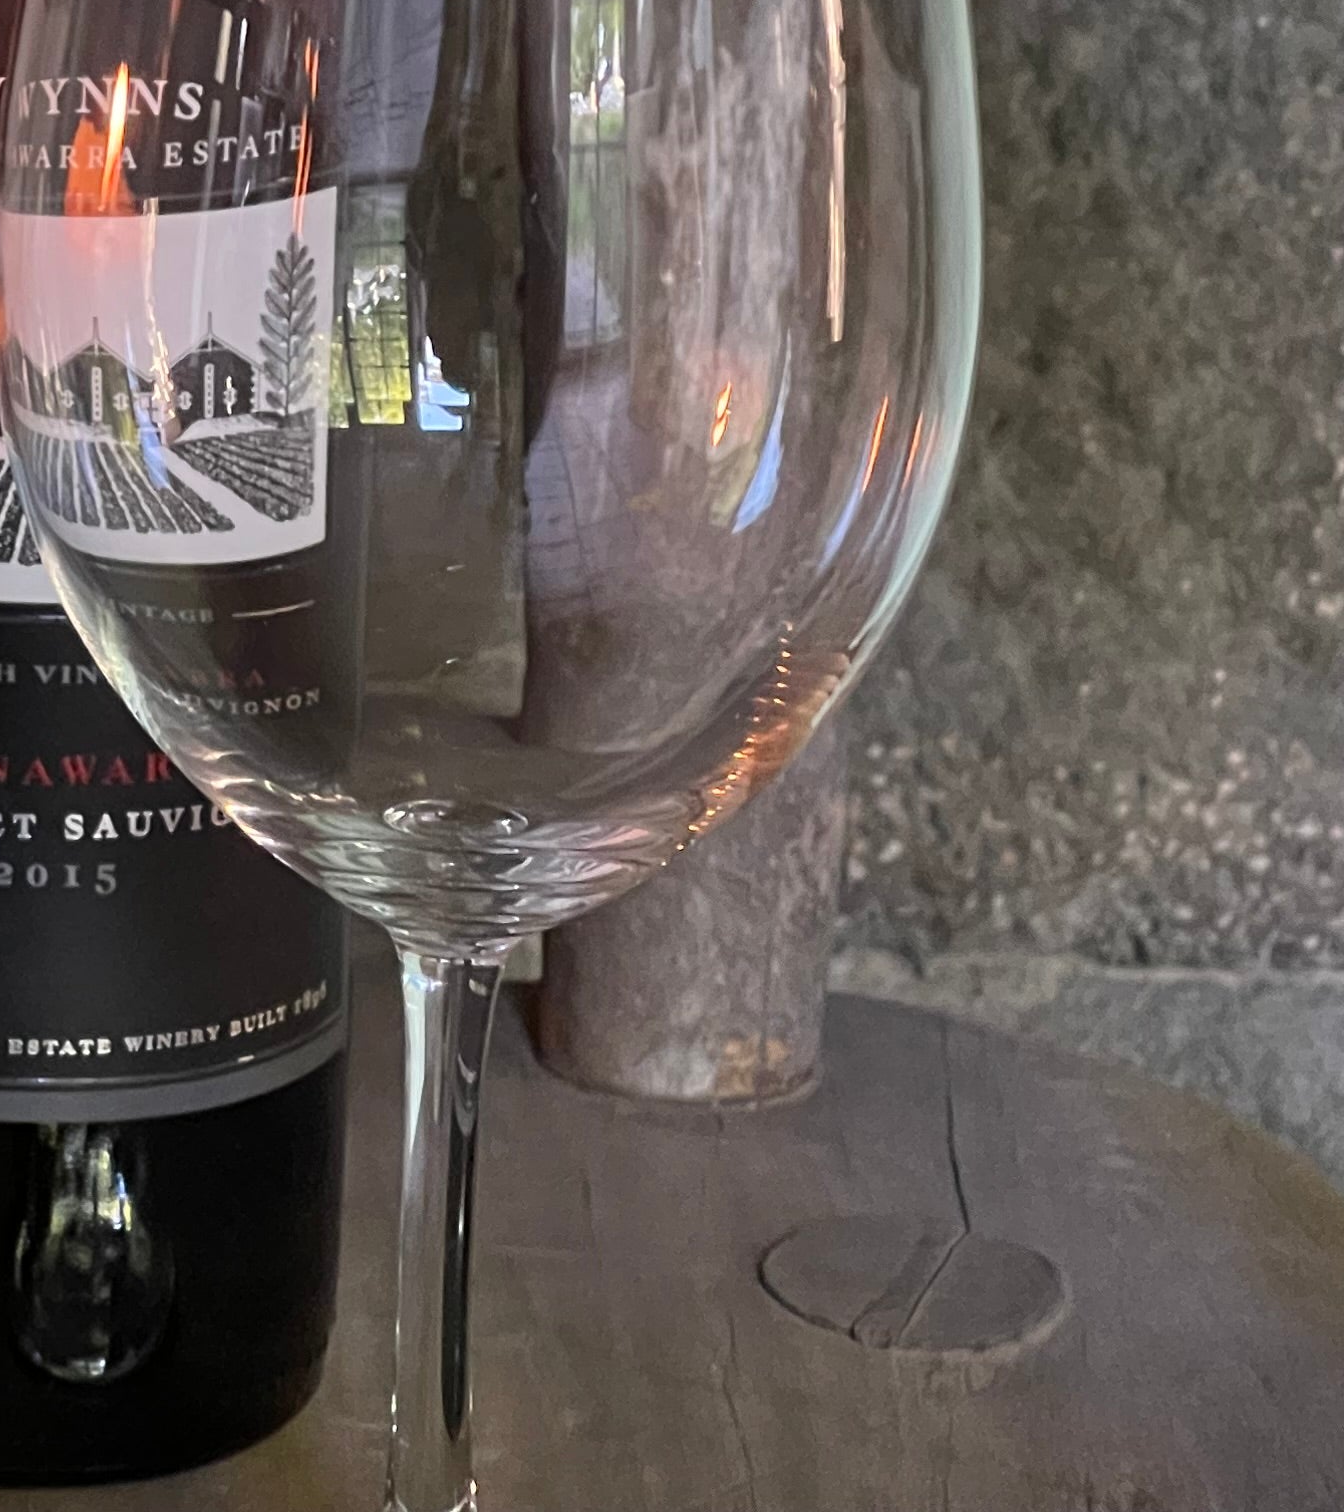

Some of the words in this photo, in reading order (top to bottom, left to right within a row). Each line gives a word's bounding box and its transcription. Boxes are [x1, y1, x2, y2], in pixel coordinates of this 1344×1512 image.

[163, 124, 304, 168] ESTATE
[7, 1038, 113, 1056] ESTATE
[123, 1024, 221, 1053] WINERY
[229, 1004, 287, 1037] BUILT
